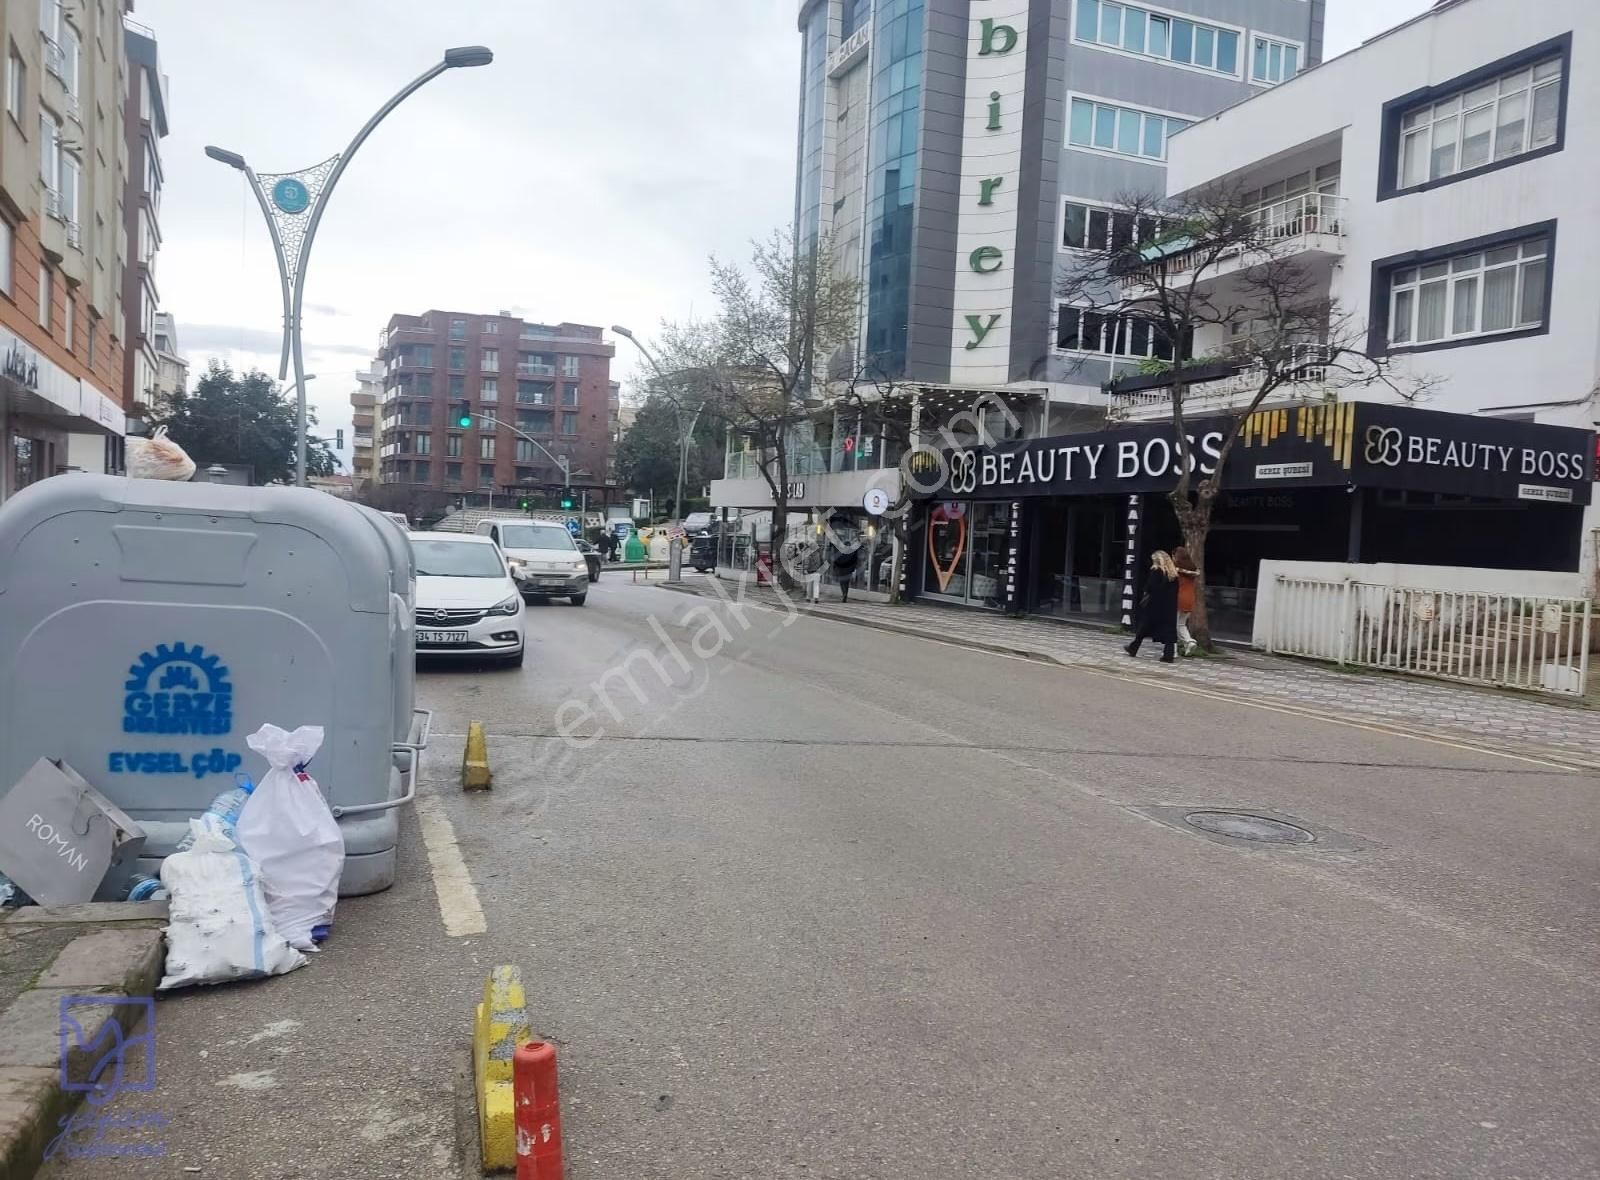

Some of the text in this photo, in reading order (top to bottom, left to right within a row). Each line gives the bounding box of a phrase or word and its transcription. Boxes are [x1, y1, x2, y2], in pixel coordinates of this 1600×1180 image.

[964, 18, 1018, 351] birey
[982, 432, 1225, 486] BEAUTY BOSS
[1407, 437, 1513, 472] BEAUTY
[1521, 449, 1584, 481] BOSS
[1121, 494, 1139, 625] ZAYIFLAMA
[418, 632, 466, 641] 34 TS 7127
[124, 691, 232, 718] GEBZE
[109, 748, 242, 779] EVSEL ÇÖP
[25, 813, 89, 873] ROMAN
